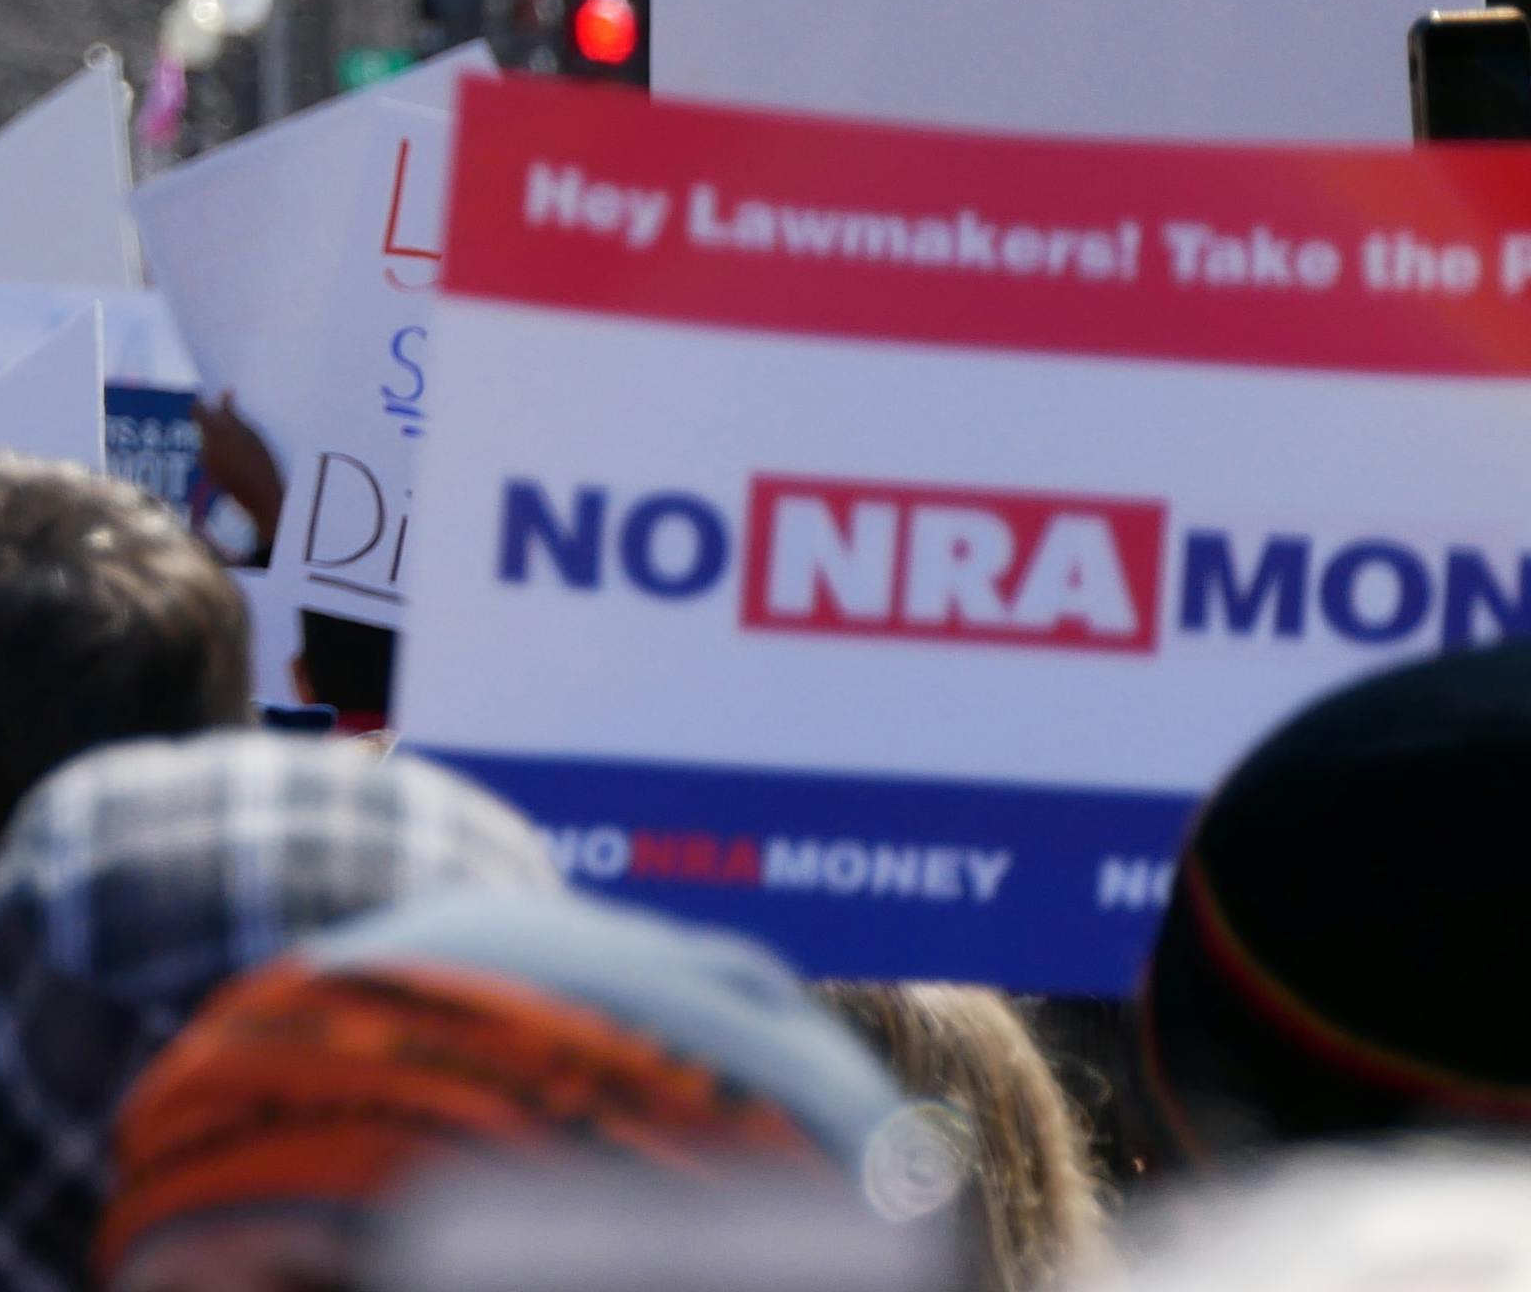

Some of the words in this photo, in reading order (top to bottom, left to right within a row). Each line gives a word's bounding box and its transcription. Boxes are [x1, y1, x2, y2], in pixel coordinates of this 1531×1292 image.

[524, 162, 670, 249] Hey
[685, 182, 1141, 282] Lawmakers!
[1163, 220, 1341, 291] Take
[1361, 226, 1484, 294] the
[496, 475, 731, 601] NO
[765, 492, 1141, 636] NRA
